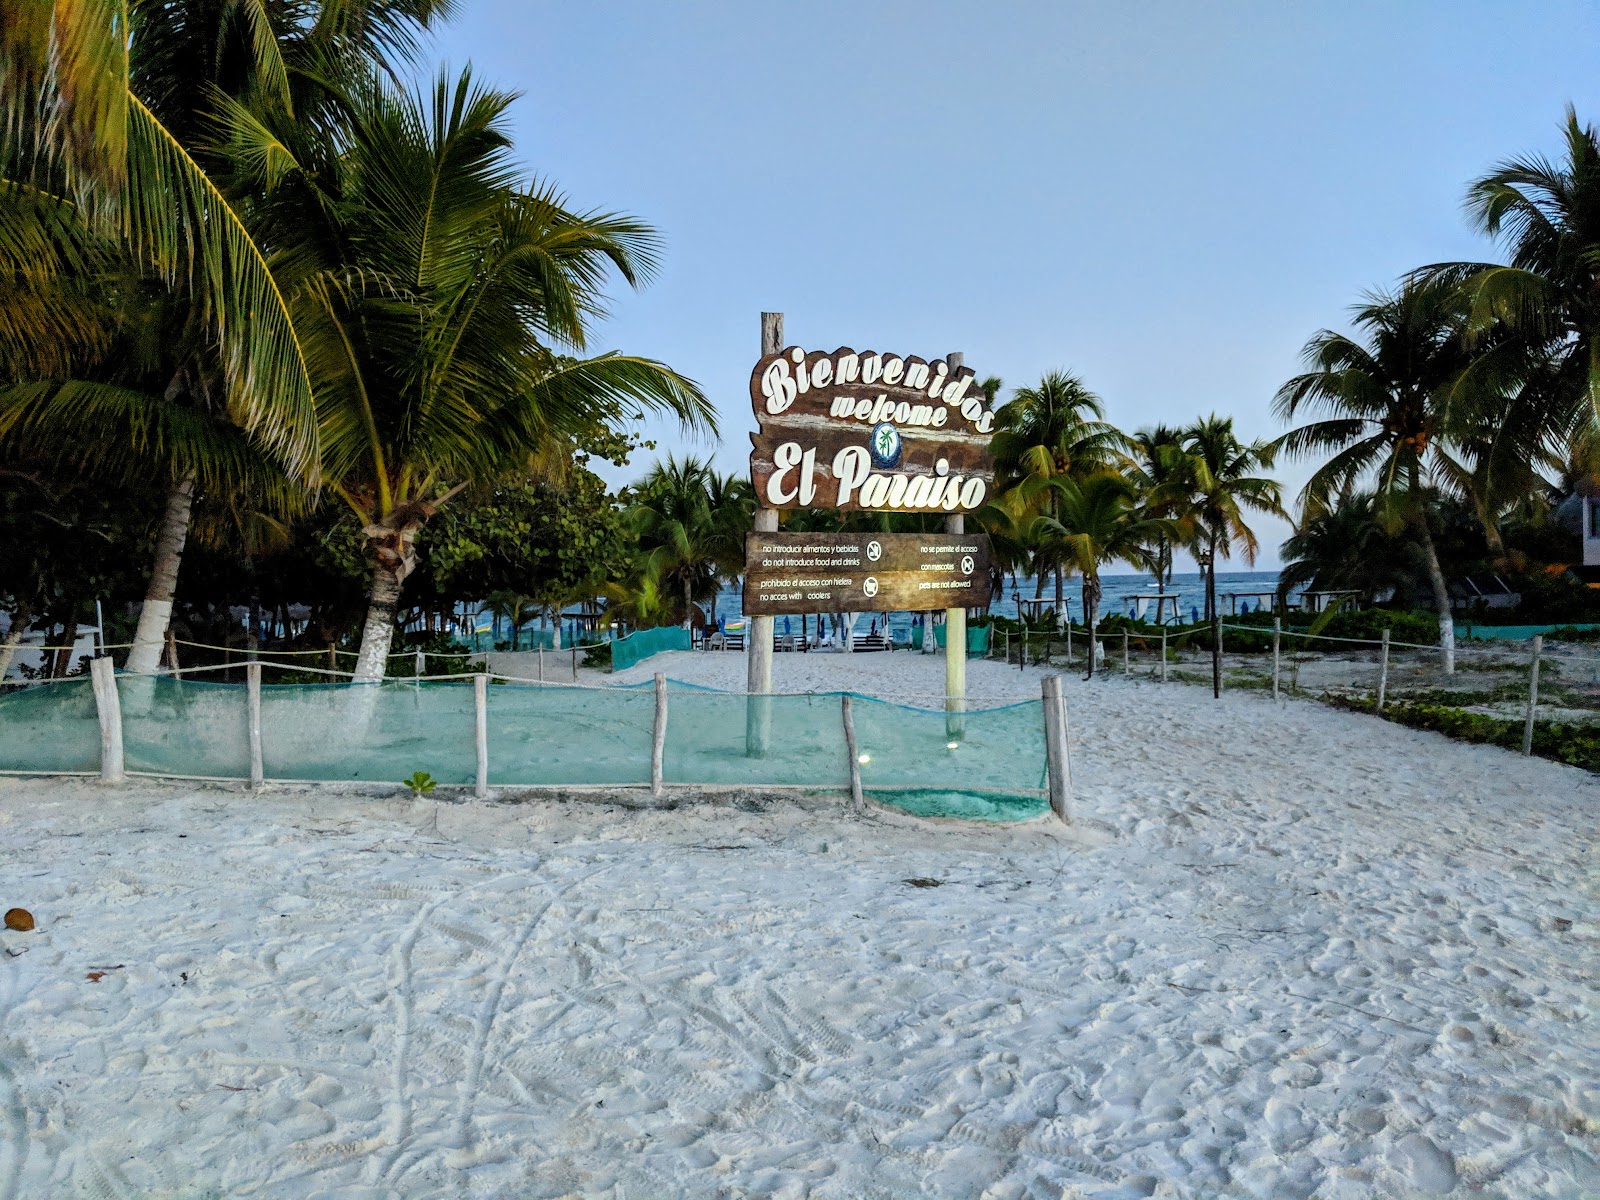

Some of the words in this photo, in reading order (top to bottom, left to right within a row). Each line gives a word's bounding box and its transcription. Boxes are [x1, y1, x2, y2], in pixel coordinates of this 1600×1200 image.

[761, 347, 995, 433] Bienvenidos
[830, 394, 948, 427] welcome
[767, 442, 817, 506] El
[832, 445, 987, 511] Paraiso
[773, 544, 802, 553] introducir
[803, 544, 830, 553] alimentos
[831, 546, 836, 554] y
[836, 544, 859, 553] bebidas
[936, 545, 954, 555] permite
[955, 545, 960, 553] el
[762, 558, 772, 566] do
[773, 558, 784, 566] not
[785, 558, 814, 566] introduce
[815, 558, 830, 566] food
[831, 558, 842, 566] and
[843, 558, 860, 566] drinks
[760, 579, 791, 589] prohibido
[792, 578, 798, 587] el
[919, 582, 931, 590] pets
[770, 593, 788, 601] acces
[788, 592, 802, 600] with
[807, 592, 831, 600] coolers
